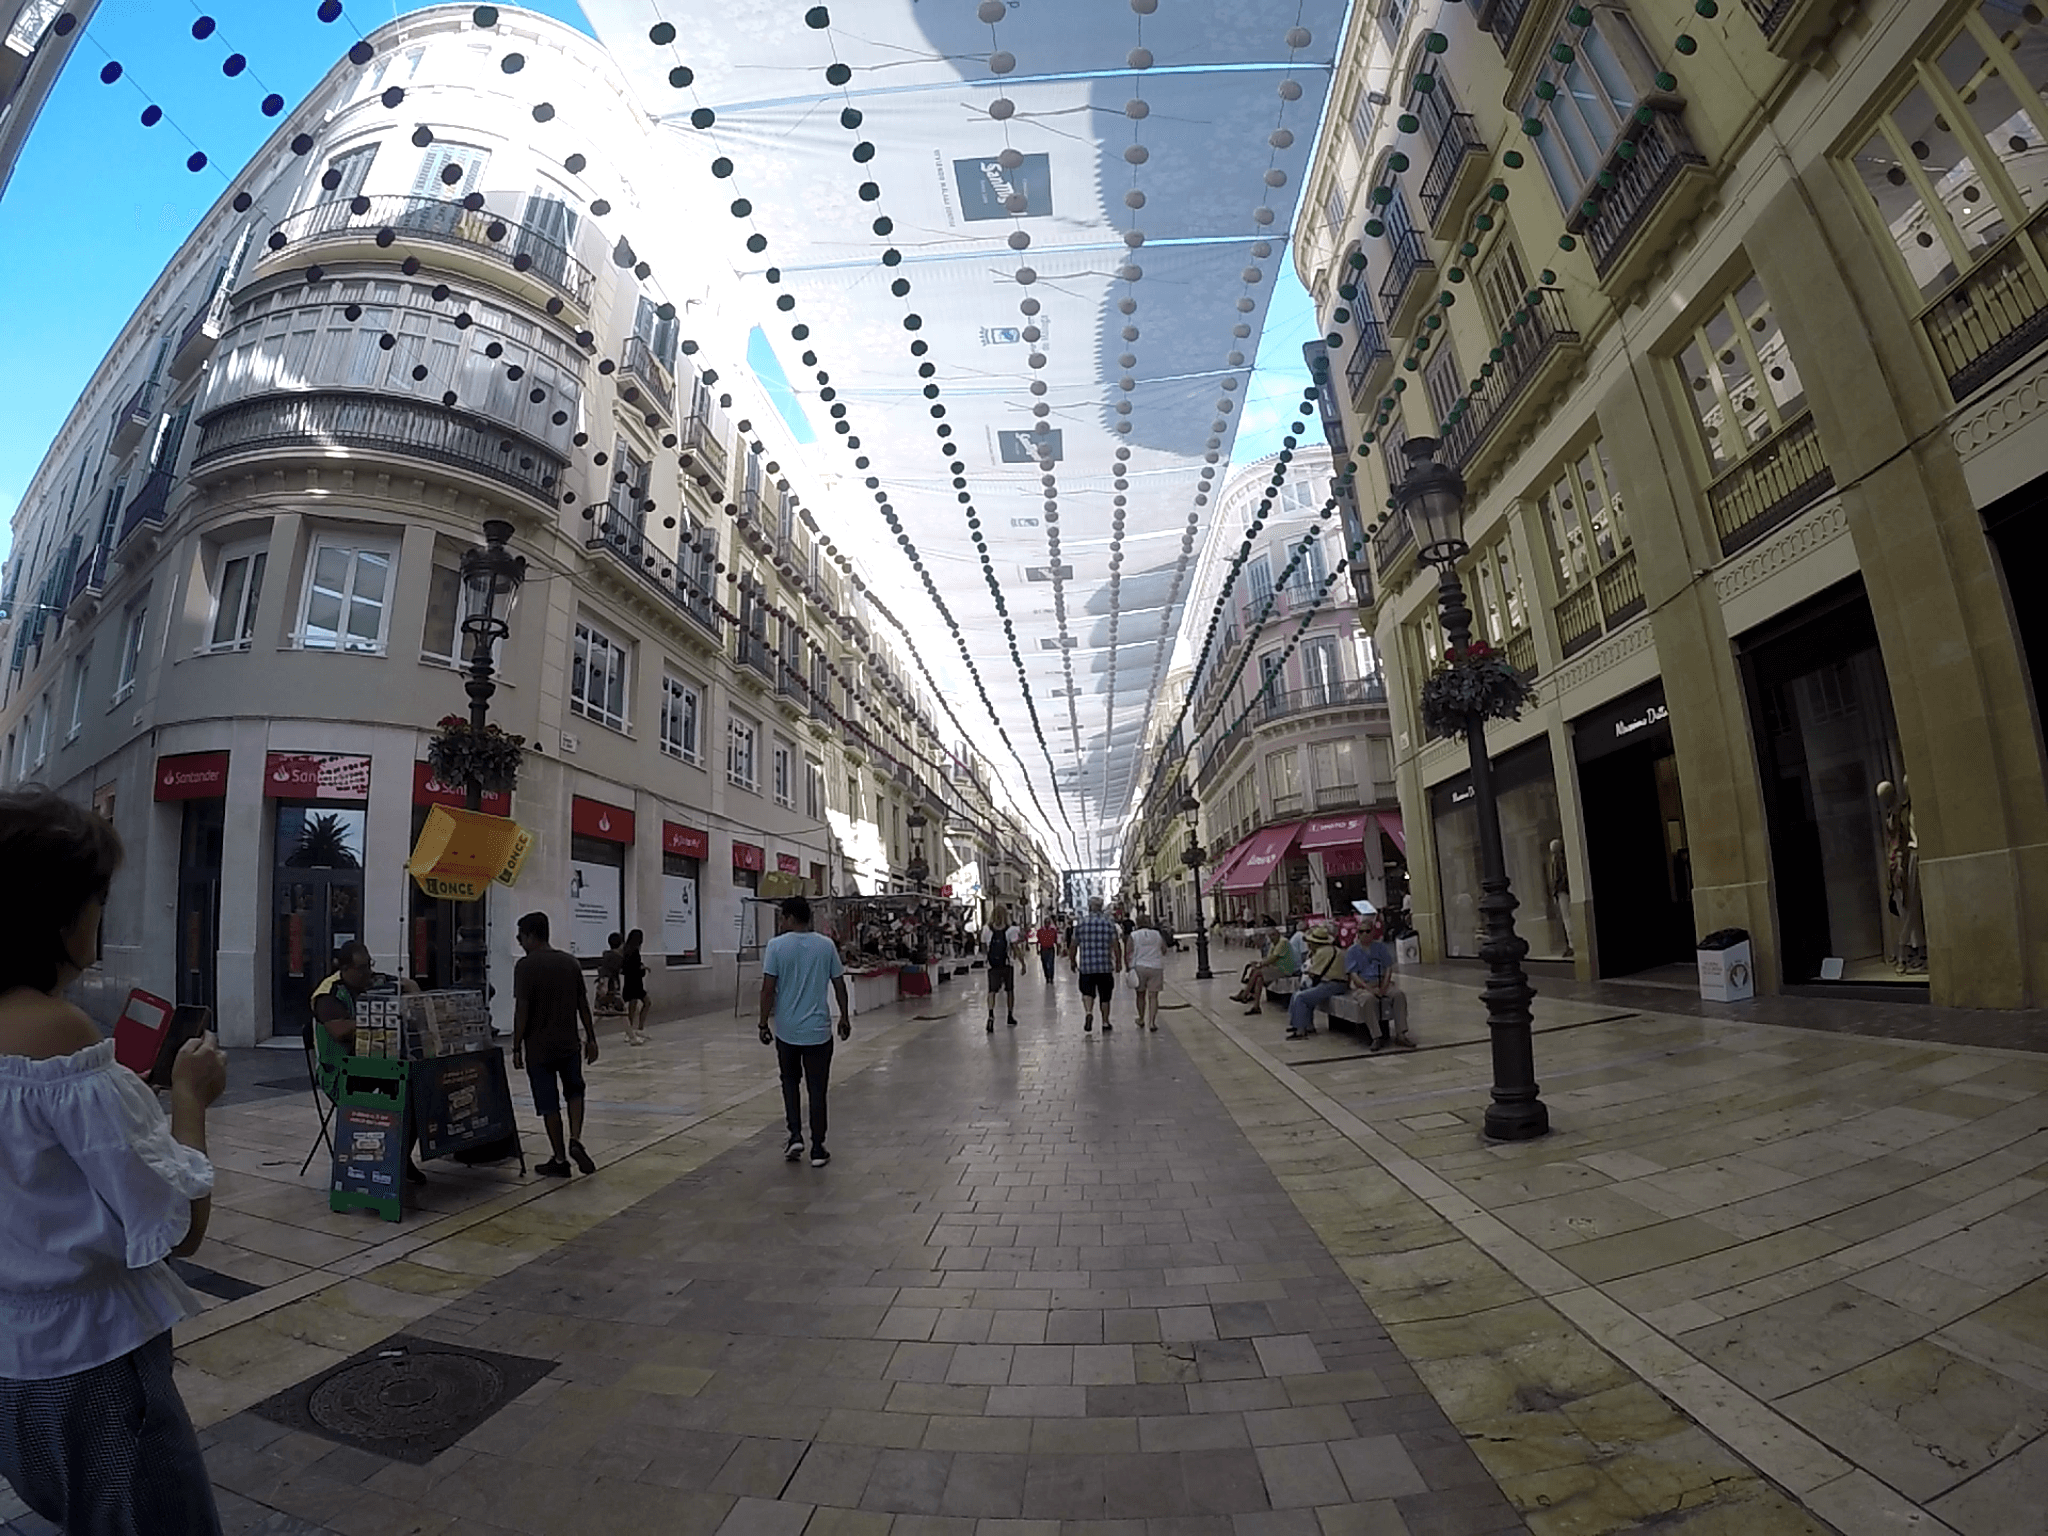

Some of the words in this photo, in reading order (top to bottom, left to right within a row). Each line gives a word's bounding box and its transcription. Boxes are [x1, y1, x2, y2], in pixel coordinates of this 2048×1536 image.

[175, 769, 220, 785] Santander
[507, 834, 528, 870] ONCE
[439, 881, 475, 896] ONCE
